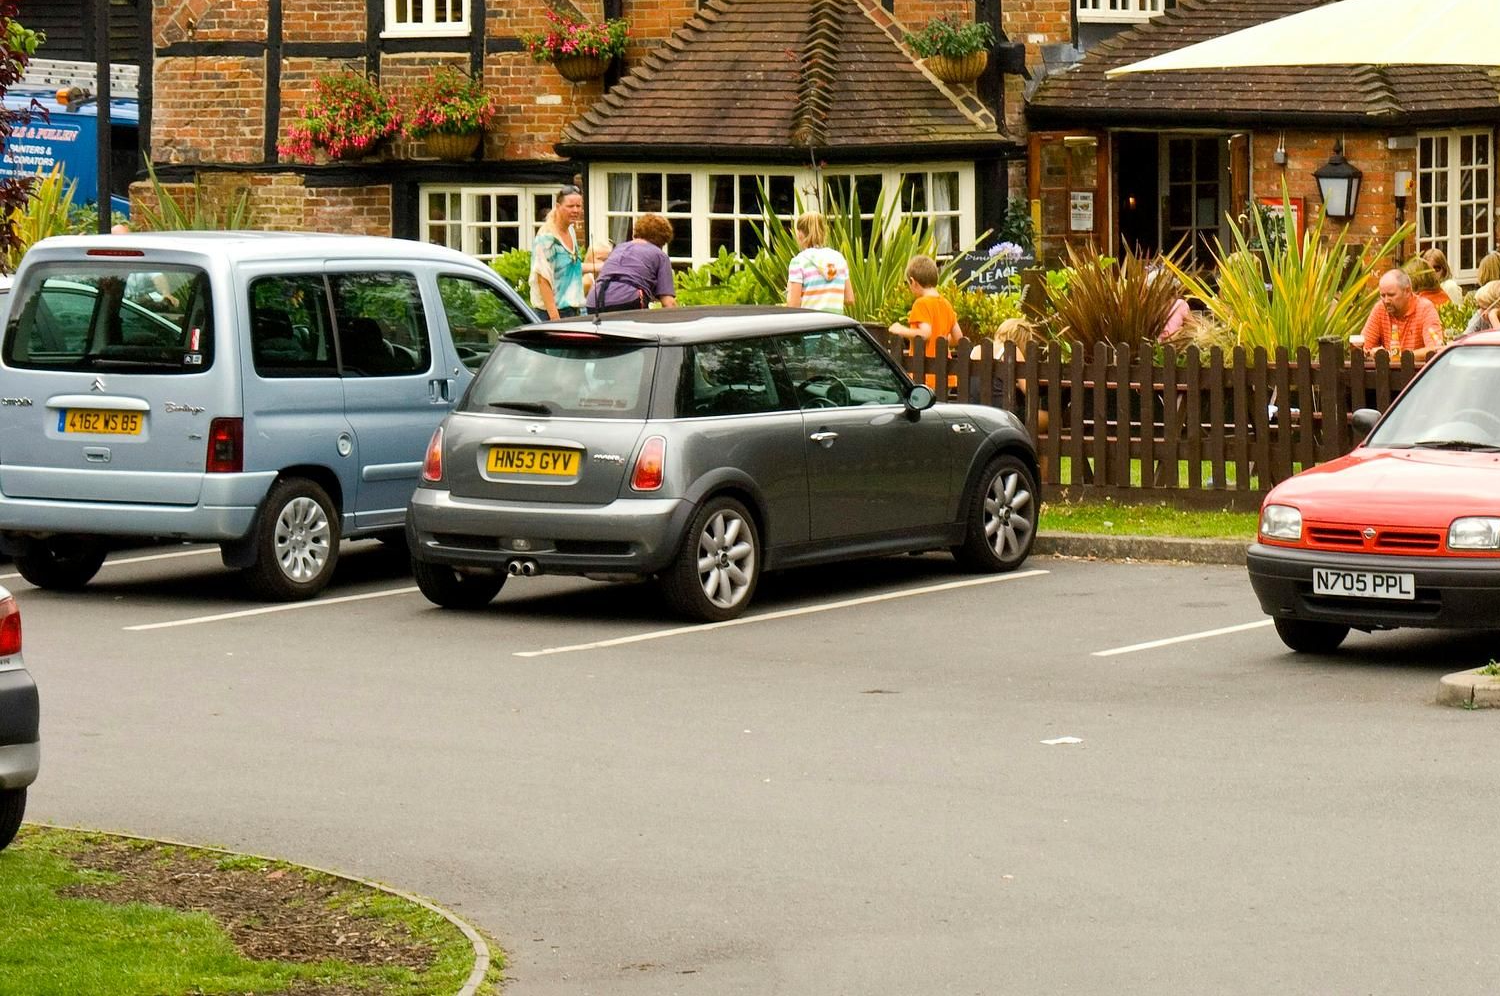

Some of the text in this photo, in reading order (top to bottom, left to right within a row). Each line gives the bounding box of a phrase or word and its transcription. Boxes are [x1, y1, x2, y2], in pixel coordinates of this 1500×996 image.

[69, 413, 138, 432] 4162 WS 85
[494, 450, 572, 471] HN53 GYV
[1317, 571, 1411, 595] N705 PPL
